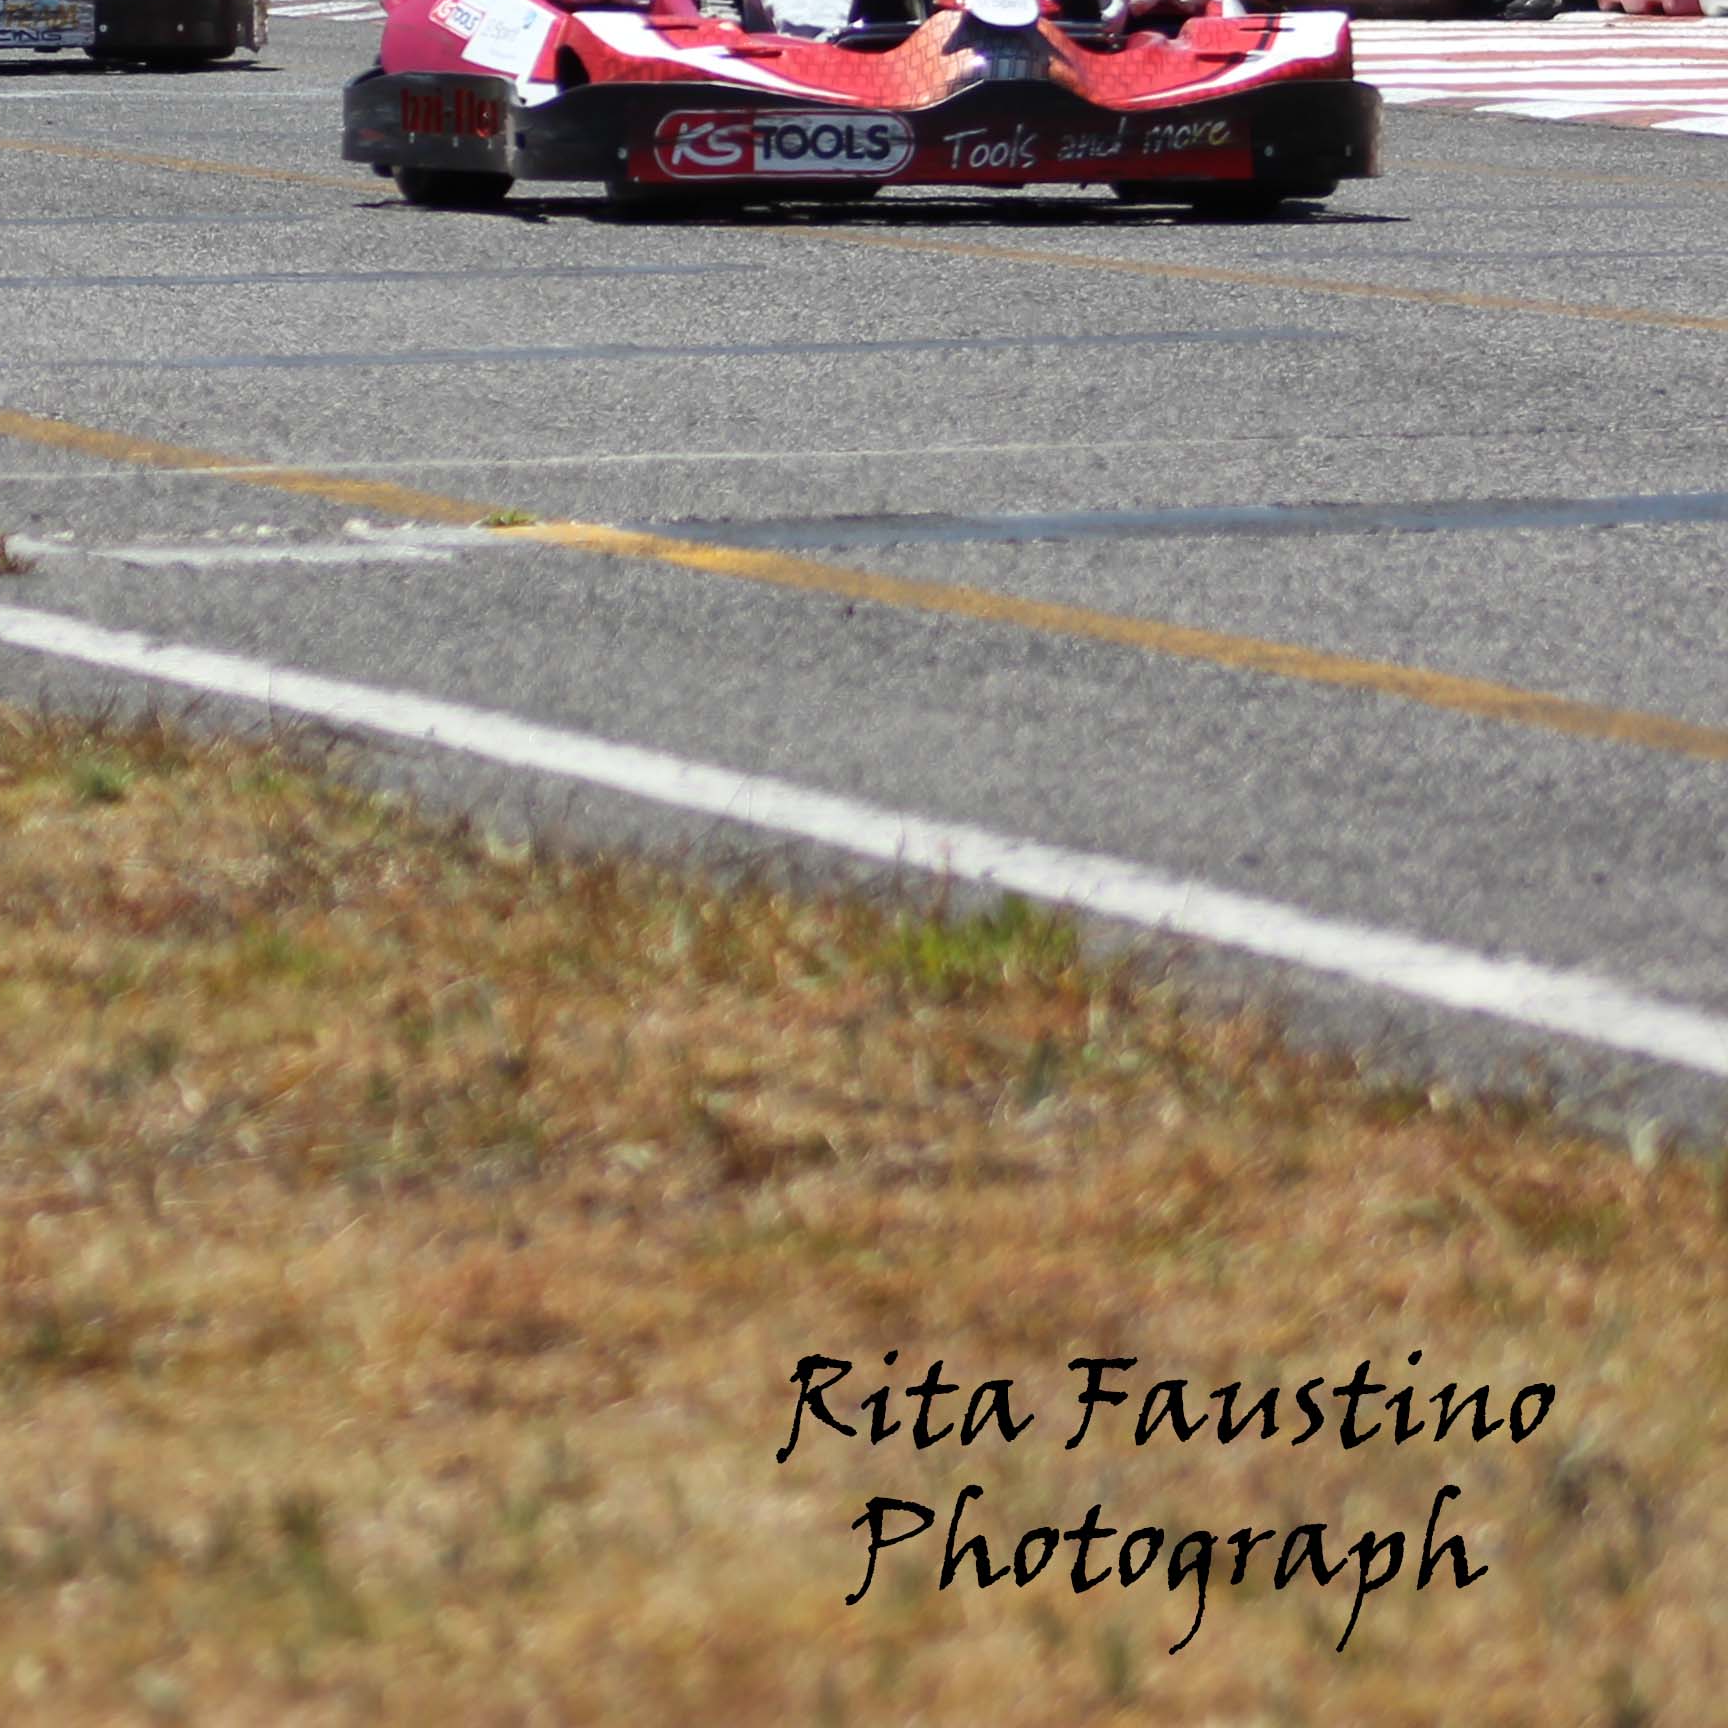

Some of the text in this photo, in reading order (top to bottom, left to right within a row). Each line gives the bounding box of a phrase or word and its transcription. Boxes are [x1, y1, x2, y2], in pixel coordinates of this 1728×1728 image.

[671, 122, 891, 166] KS TOOLS
[943, 116, 1232, 170] Tools and more
